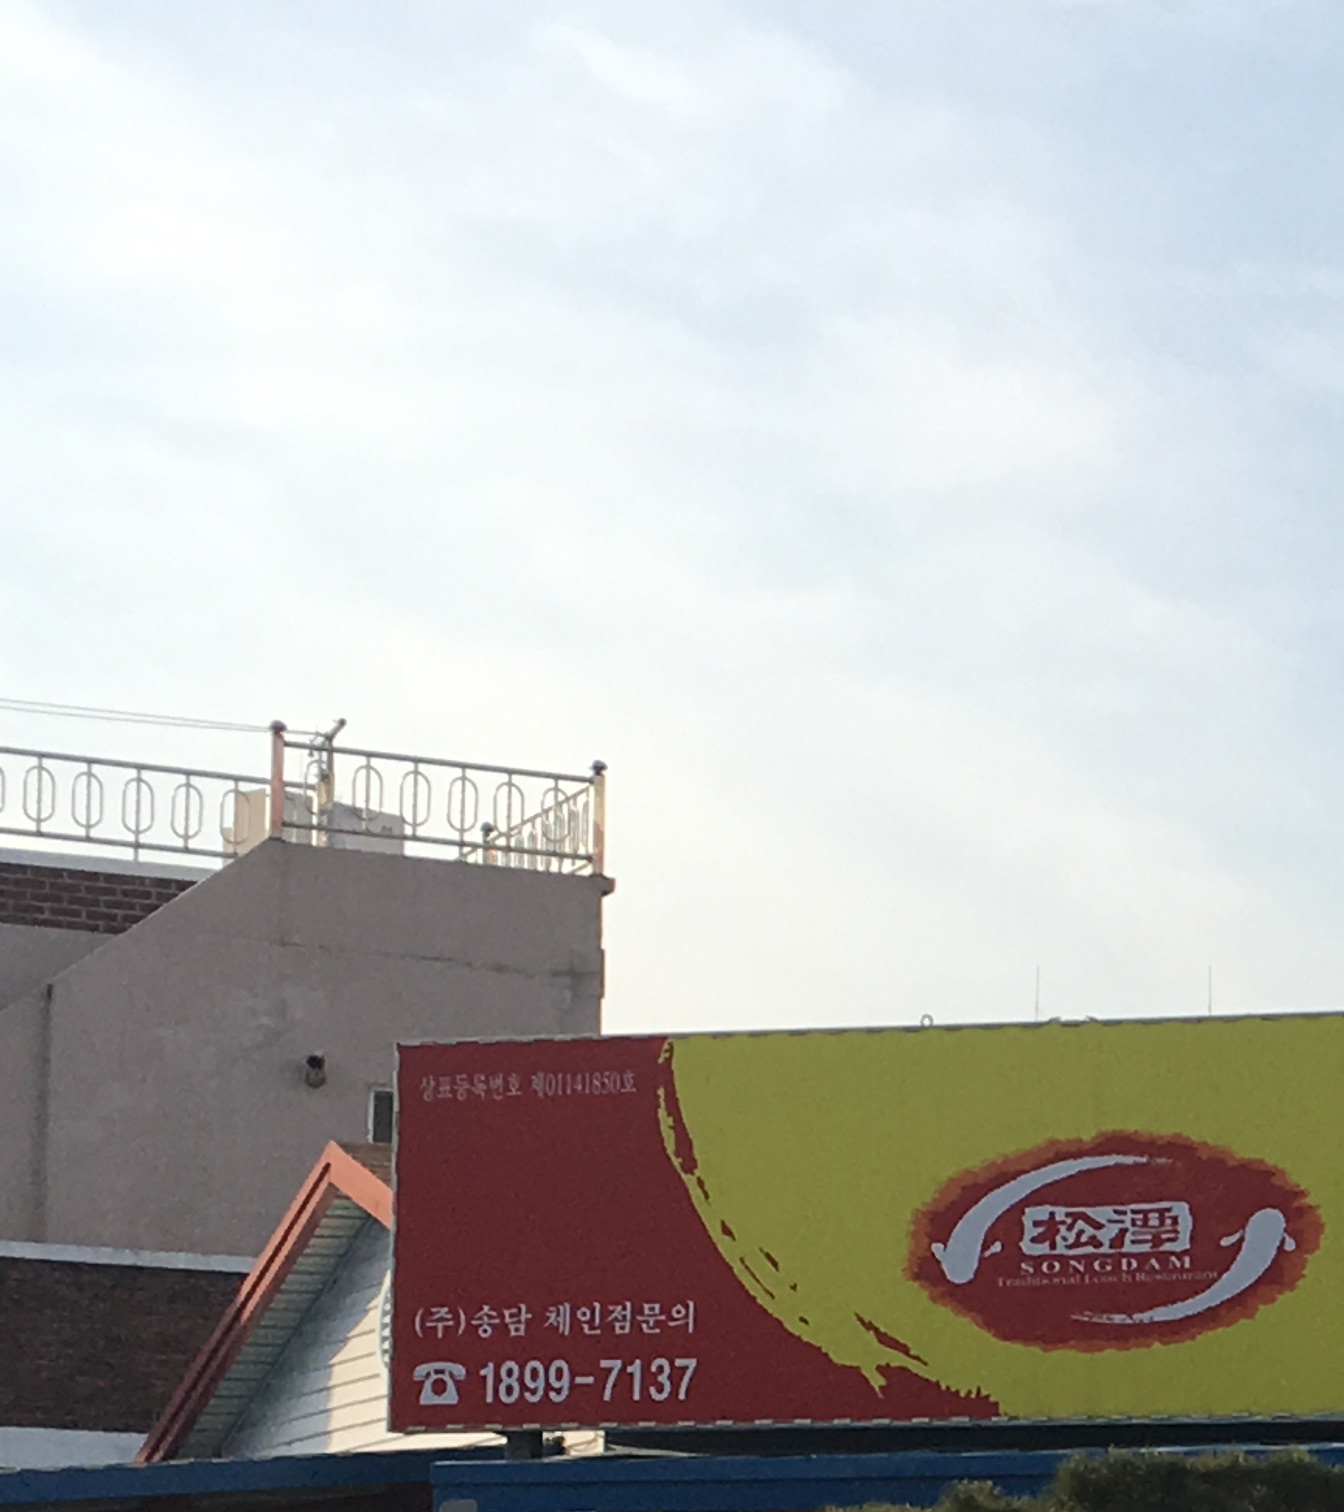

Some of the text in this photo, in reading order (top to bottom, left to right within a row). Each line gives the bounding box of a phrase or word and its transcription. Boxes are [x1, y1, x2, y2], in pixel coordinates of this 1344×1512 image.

[1020, 1254, 1192, 1276] SONGDAM
[414, 1299, 696, 1338] (주)송담 체인점문의
[479, 1357, 698, 1406] 1899-7137
